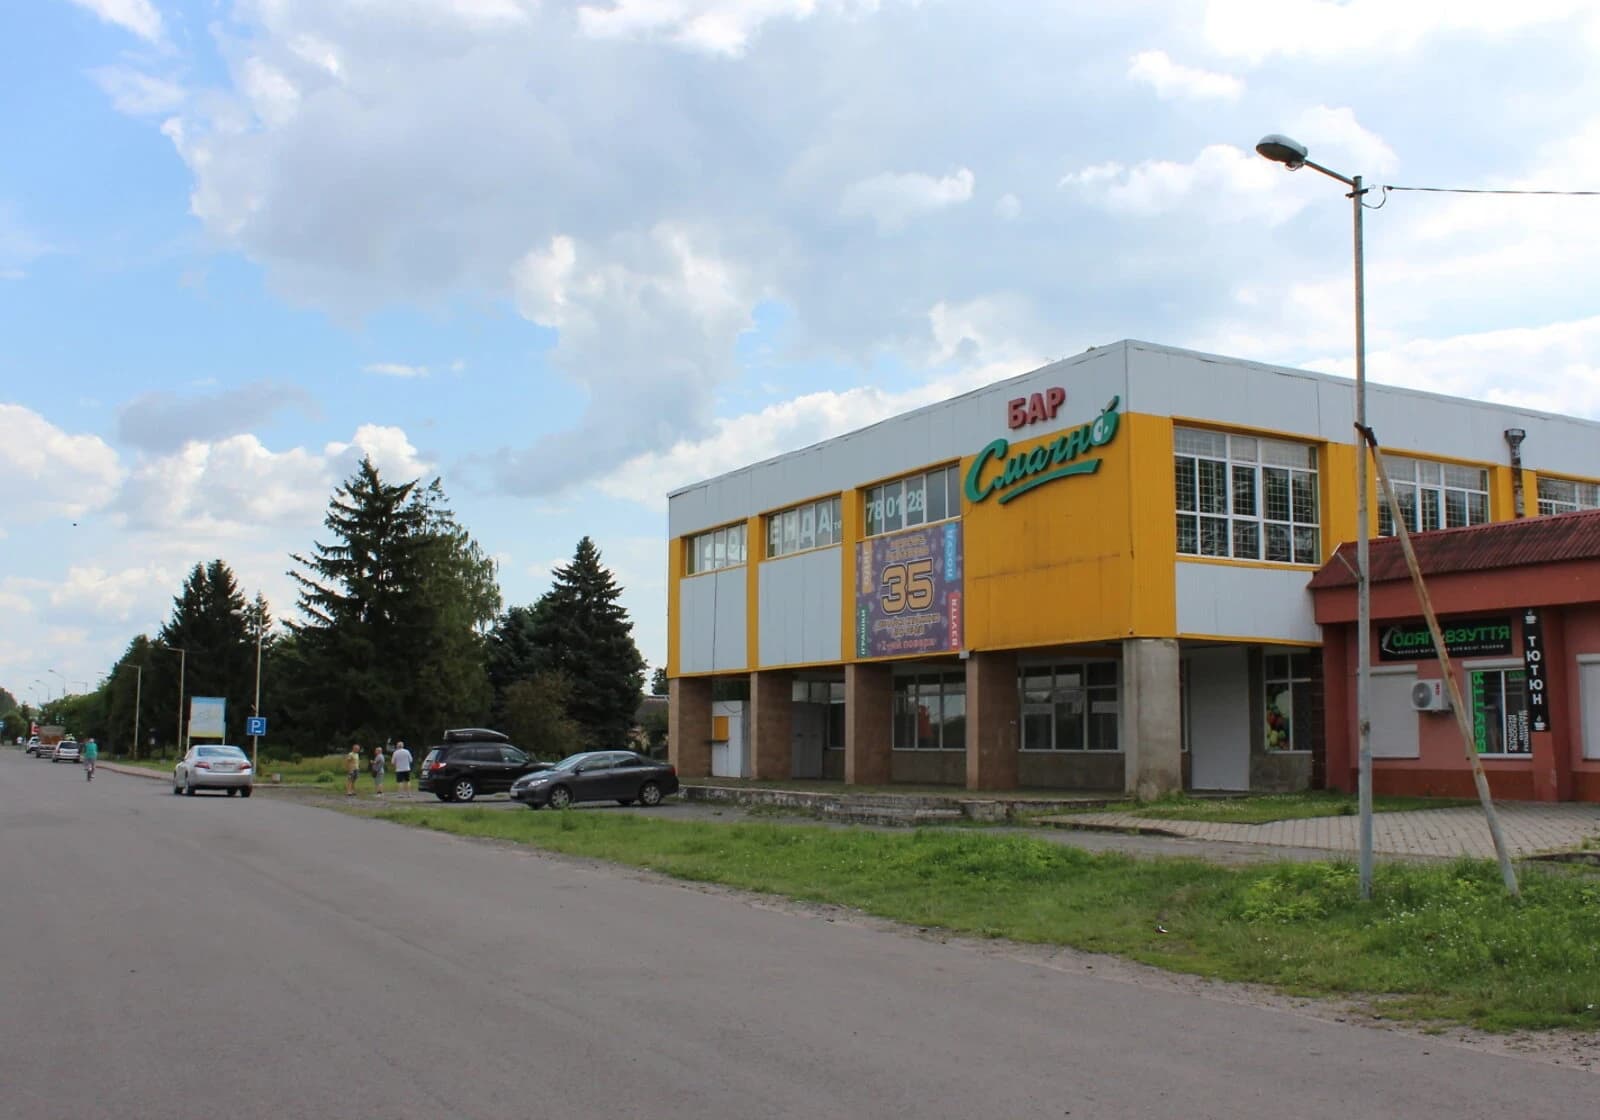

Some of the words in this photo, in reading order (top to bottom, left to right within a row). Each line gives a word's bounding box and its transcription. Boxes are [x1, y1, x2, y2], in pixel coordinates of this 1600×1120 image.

[1008, 387, 1066, 429] БАР
[964, 396, 1120, 503] Смачно
[882, 558, 934, 614] 35
[1445, 625, 1510, 643] ВЗУТТЯ
[1526, 636, 1543, 705] ТЮТЮН
[251, 720, 261, 733] P
[1472, 671, 1486, 753] ВЗУТТЯ
